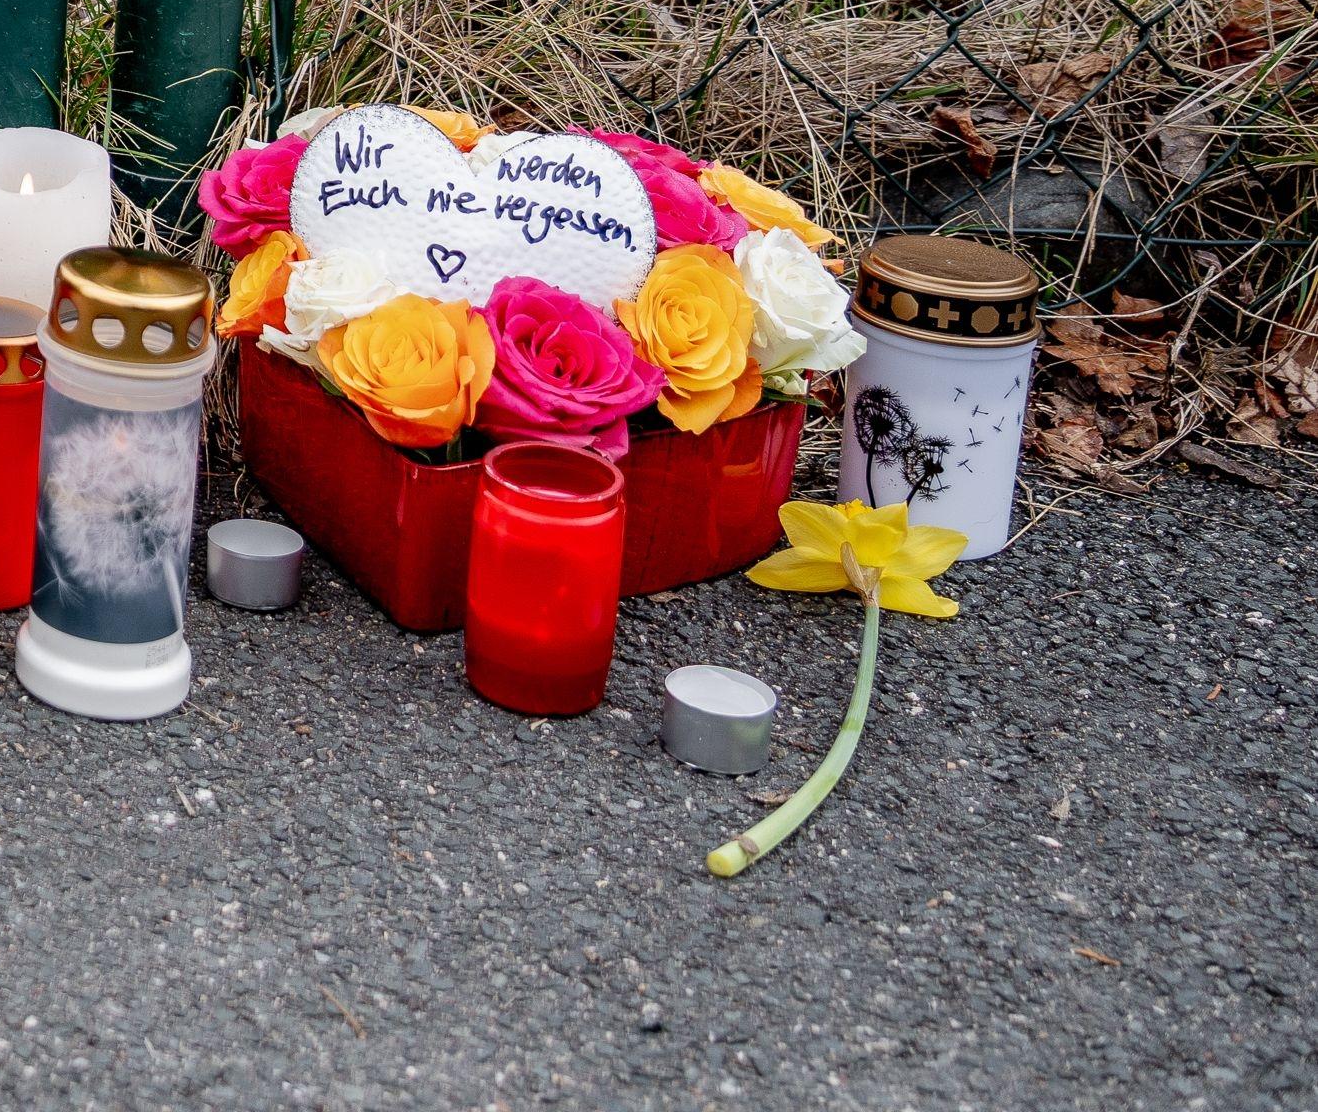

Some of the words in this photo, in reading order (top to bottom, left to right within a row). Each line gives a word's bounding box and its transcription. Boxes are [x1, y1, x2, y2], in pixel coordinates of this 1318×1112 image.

[334, 124, 394, 174] Wir
[497, 153, 603, 197] werden
[318, 178, 408, 217] Euch
[426, 181, 488, 215] nie
[494, 192, 638, 253] vergessen.
